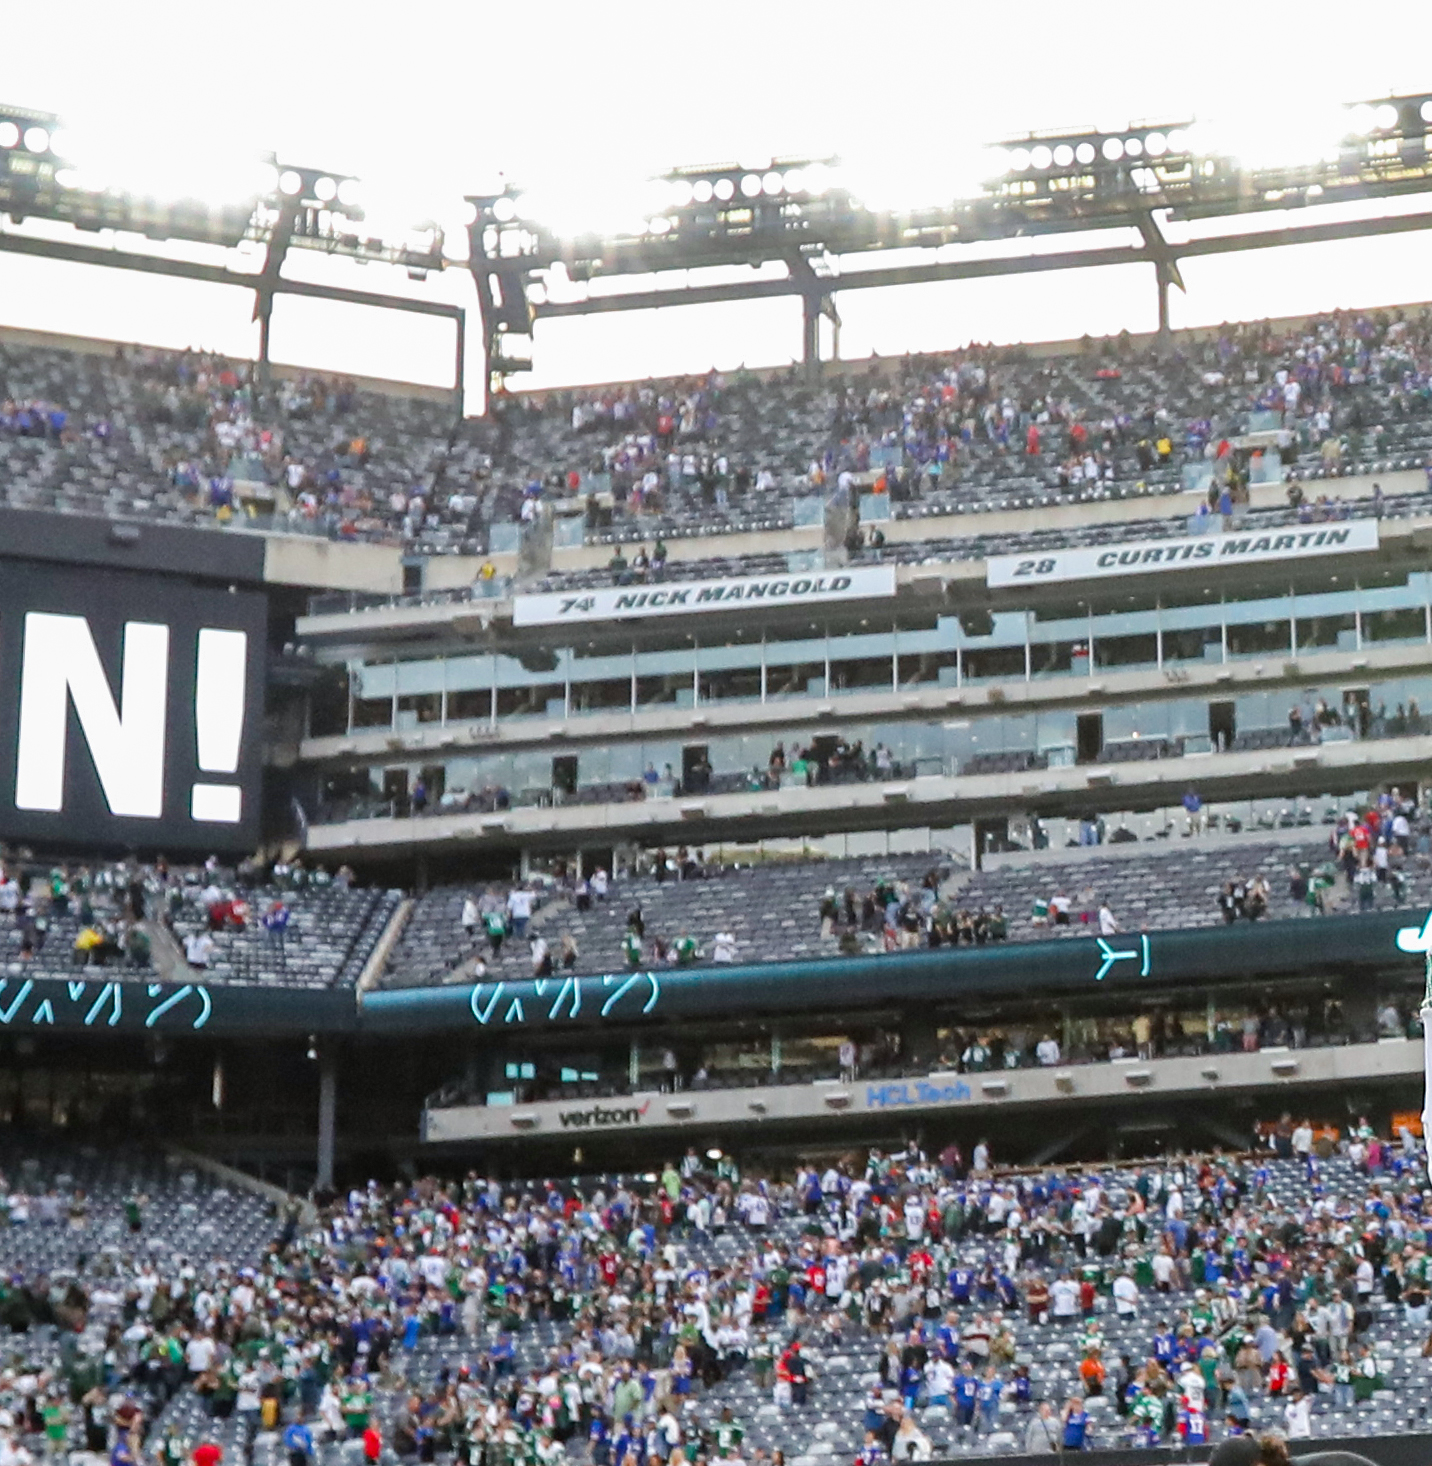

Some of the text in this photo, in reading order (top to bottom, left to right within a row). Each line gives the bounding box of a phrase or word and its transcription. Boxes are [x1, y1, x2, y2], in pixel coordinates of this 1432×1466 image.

[1012, 528, 1351, 577] 28 CURTIS MARTIN
[557, 576, 852, 614] 74 NICK MANGOLD
[559, 1104, 640, 1127] verizon
